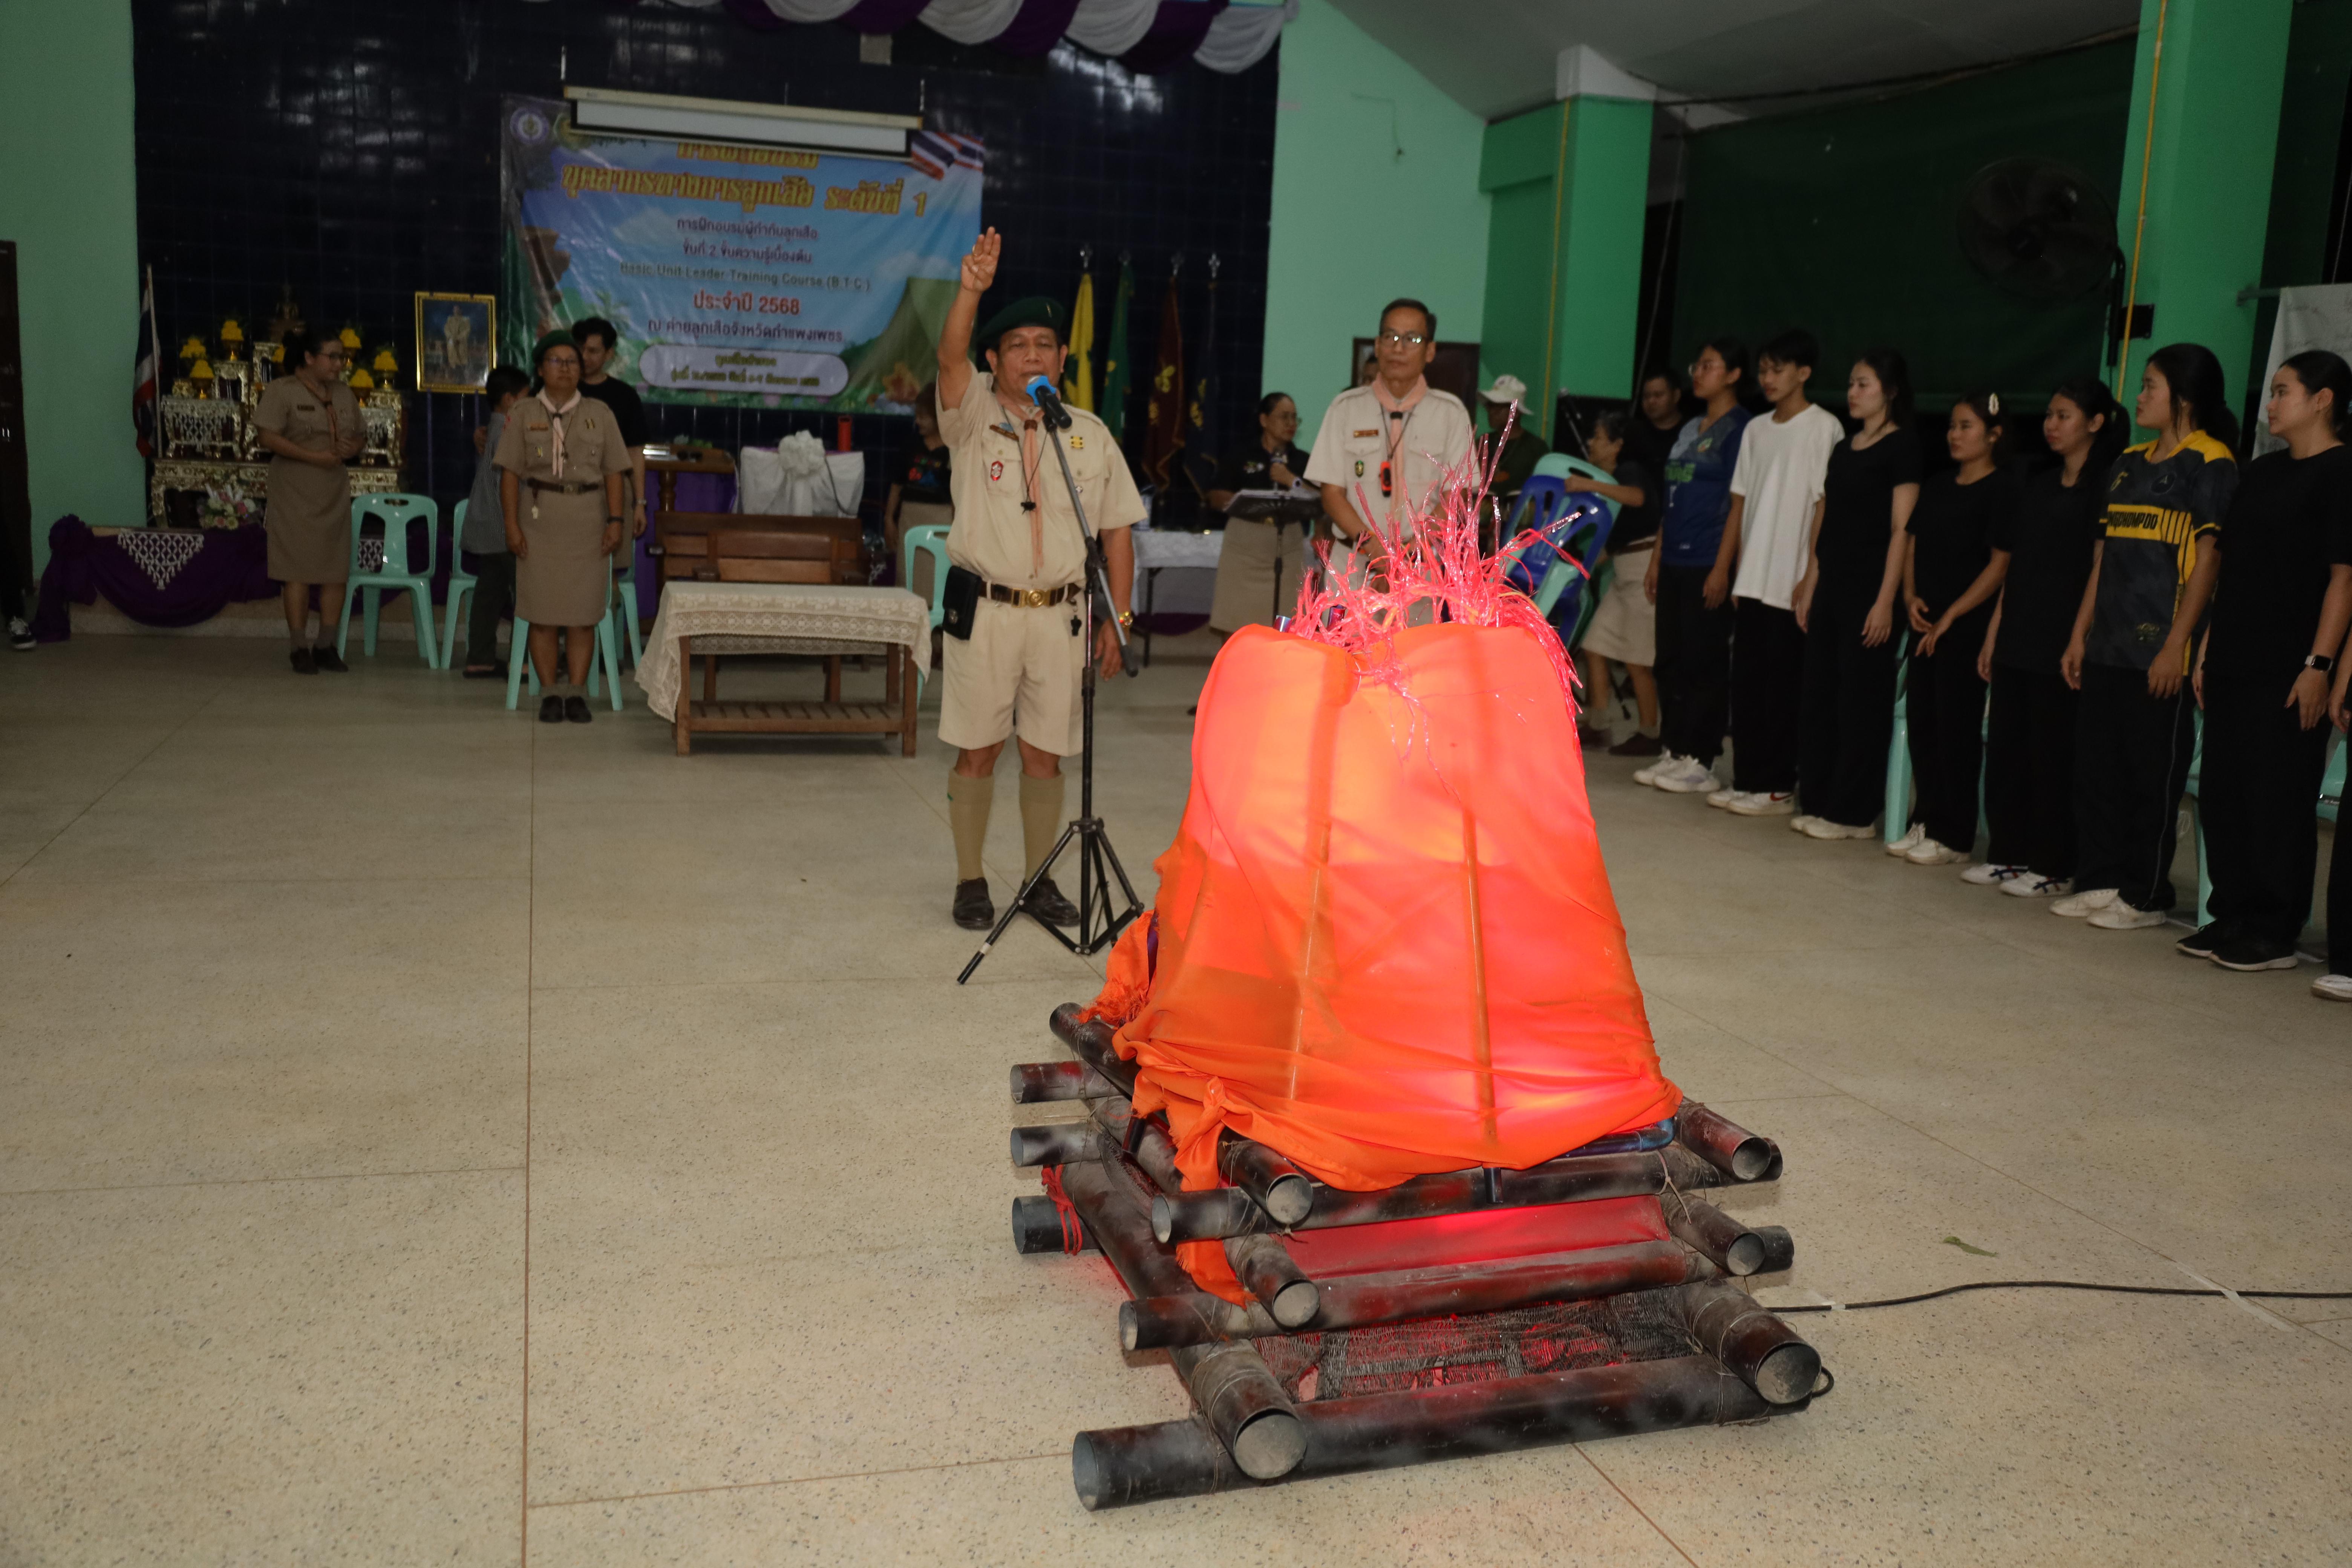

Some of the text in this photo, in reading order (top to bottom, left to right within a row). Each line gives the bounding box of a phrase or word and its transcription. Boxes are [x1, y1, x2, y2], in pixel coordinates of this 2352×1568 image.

[676, 142, 819, 169] การฝกอบรม
[824, 178, 904, 214] ระดับที่
[913, 191, 926, 217] 1
[709, 244, 716, 257] 2
[620, 262, 653, 275] Basic
[657, 264, 681, 276] Unit
[686, 266, 724, 280] Leader
[730, 268, 778, 286] Training
[781, 273, 822, 286] Course
[694, 289, 800, 315] ประจำปี 2568
